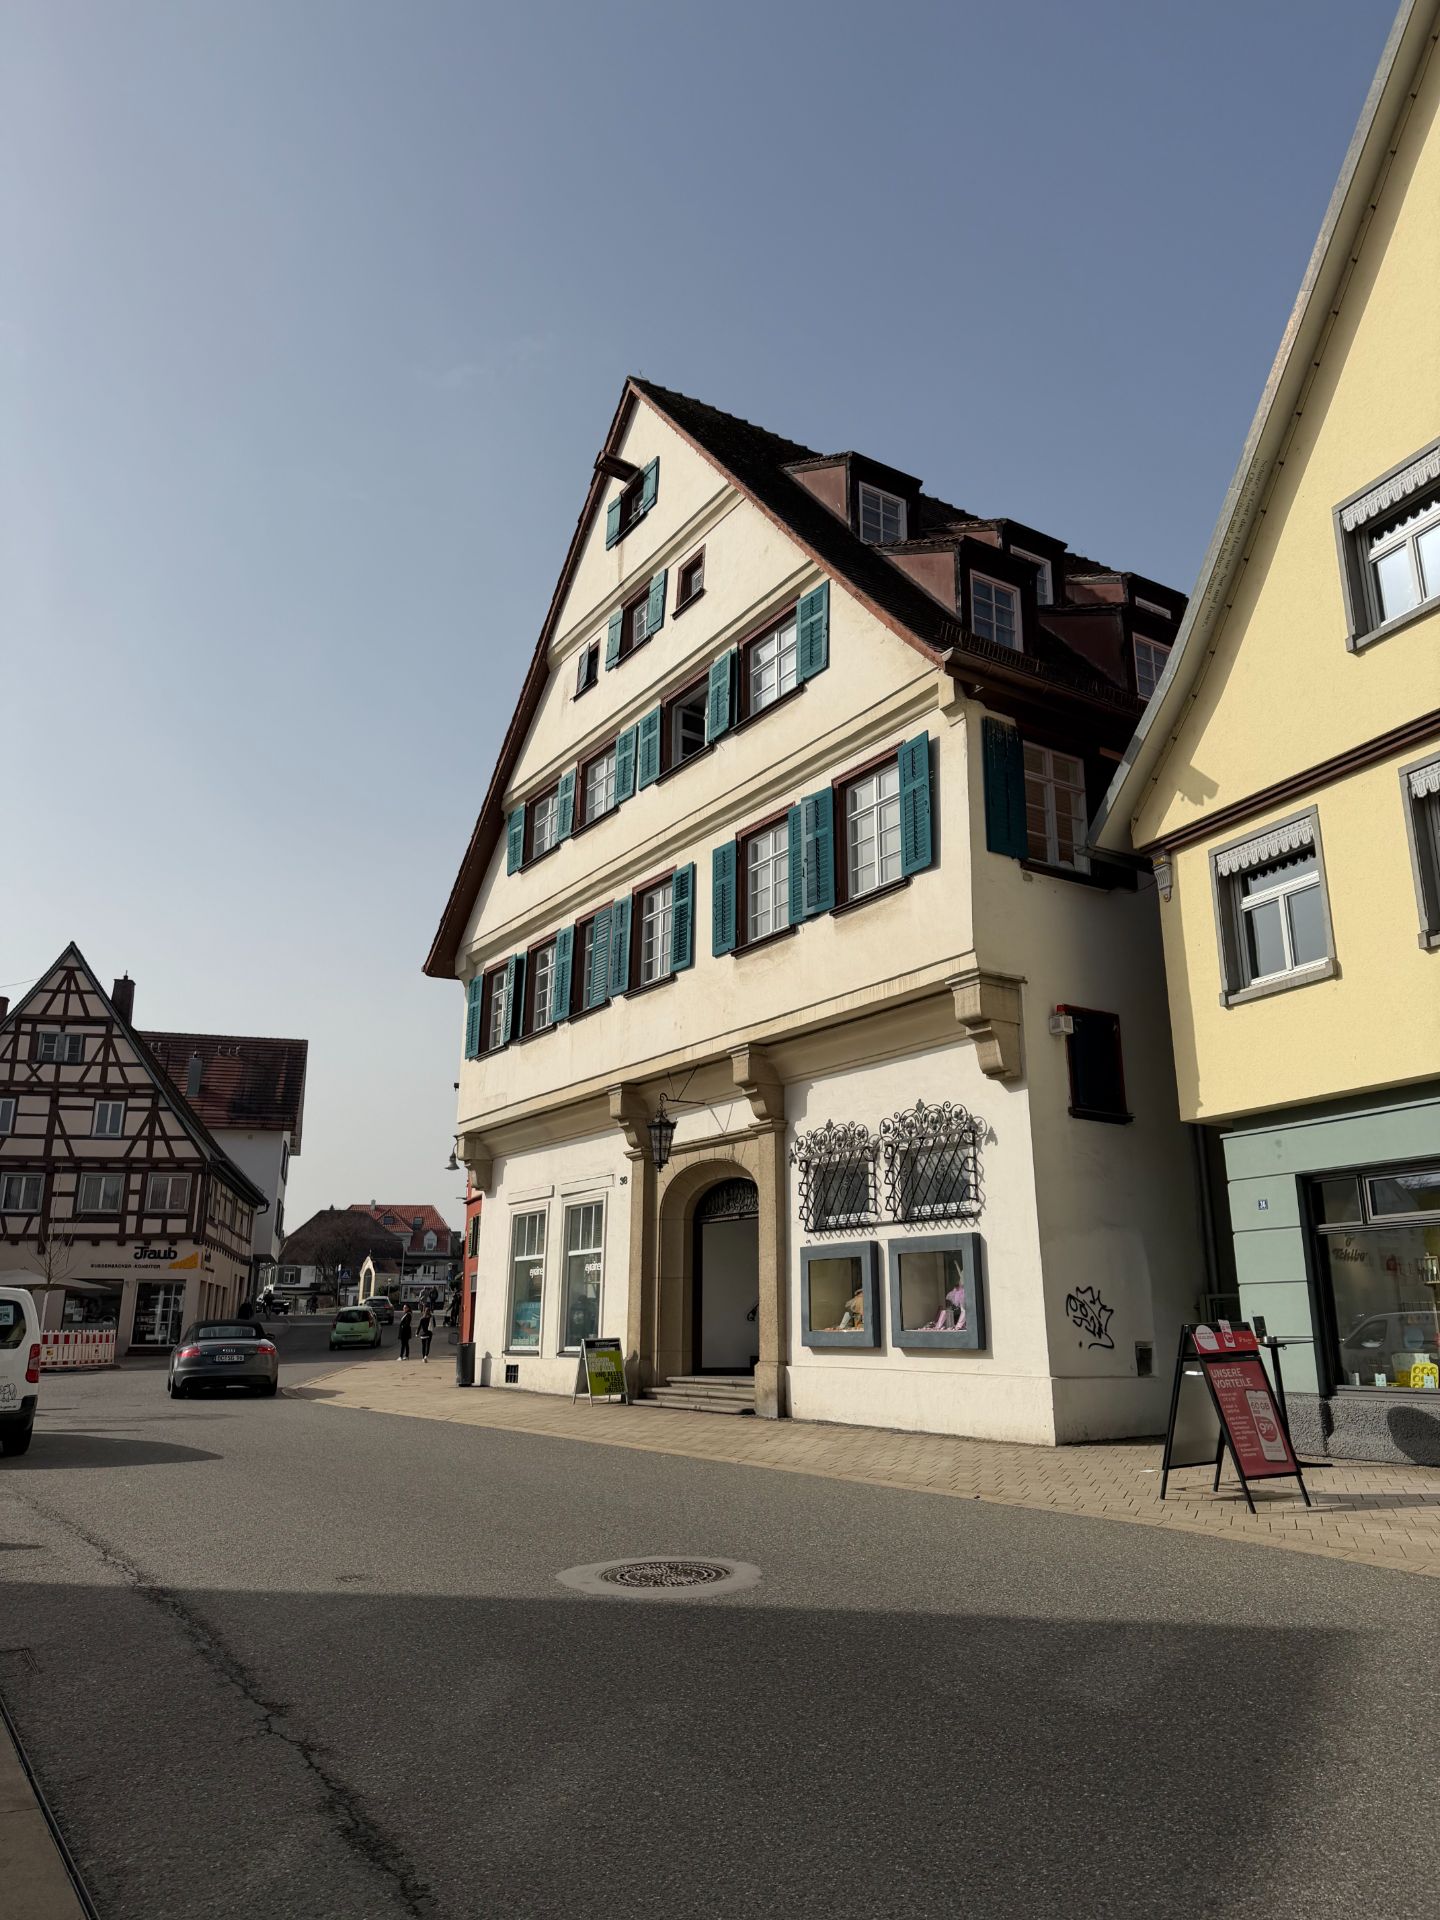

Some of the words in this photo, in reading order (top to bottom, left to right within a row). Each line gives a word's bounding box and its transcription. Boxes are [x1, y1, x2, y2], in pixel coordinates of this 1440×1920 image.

[619, 1175, 628, 1186] 38
[133, 1246, 178, 1260] Traub
[1210, 1367, 1244, 1378] UNSERE
[1215, 1378, 1254, 1389] VORTEILE
